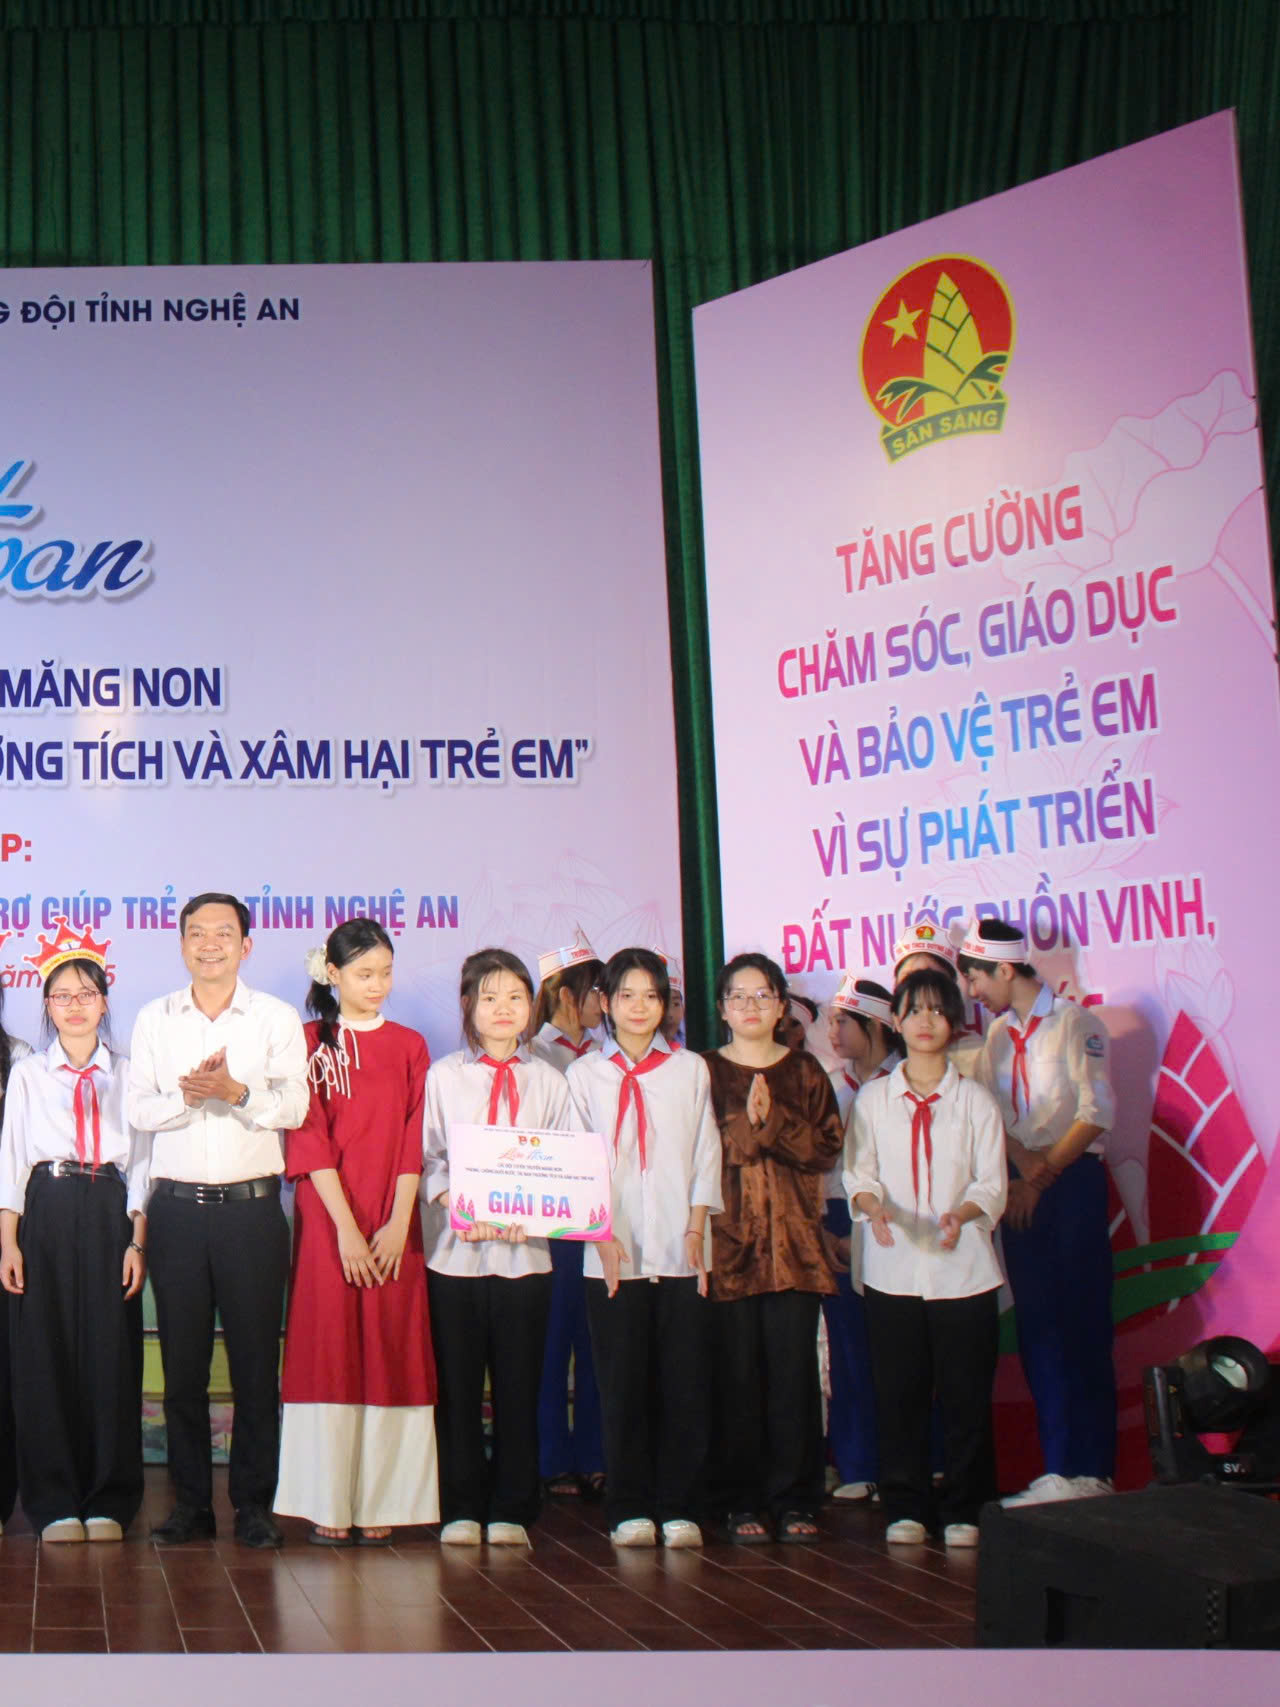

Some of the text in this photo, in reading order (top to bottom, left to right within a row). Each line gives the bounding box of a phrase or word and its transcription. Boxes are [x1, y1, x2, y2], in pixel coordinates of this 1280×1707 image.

[20, 295, 75, 330] ĐỘI
[85, 292, 152, 322] TỈNH
[164, 292, 246, 328] NGHỆ
[257, 298, 300, 321] AN
[836, 485, 1084, 593] TĂNG CƯỜNG
[778, 565, 1178, 698] CHĂM SÓC, GIÁO DỤC
[133, 667, 221, 707] NON
[73, 731, 163, 780] TÍCH
[173, 730, 233, 780] VÀ
[239, 729, 331, 780] XÂM
[344, 739, 410, 789] HẠI
[420, 727, 500, 779] TRẺ
[799, 673, 1159, 786] VÀ BẢO VỆ TRẺ EM
[812, 759, 1156, 882] VÌ SỰ PHÁT TRIỂN
[41, 889, 112, 931] GIÚP
[122, 884, 177, 930] TRẺ
[245, 885, 314, 930] TỈNH
[325, 888, 406, 936] NGHỆ
[416, 895, 459, 929] AN
[782, 899, 852, 975] ĐẤT
[1097, 878, 1216, 945] VINH,
[488, 1185, 572, 1219] GIẢI BA
